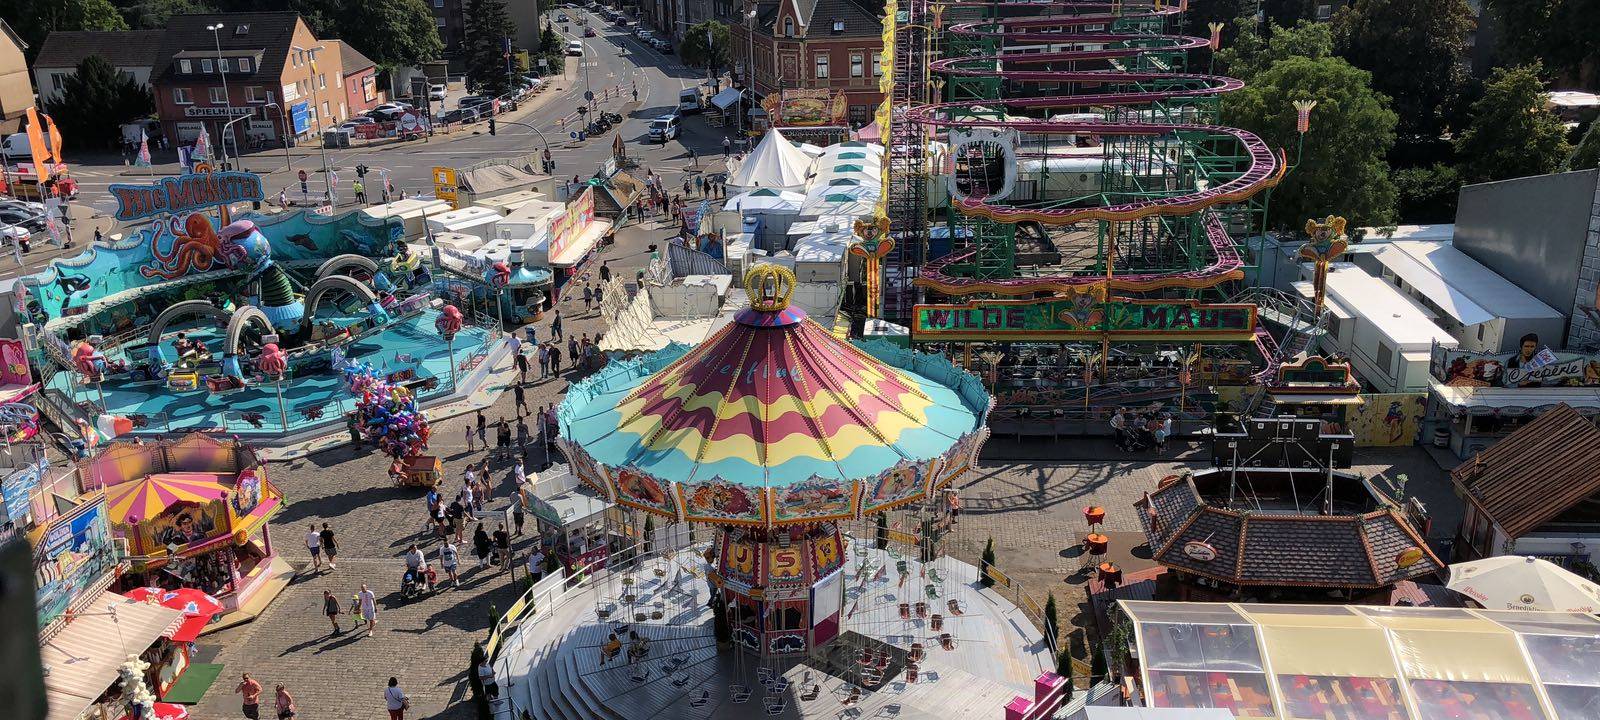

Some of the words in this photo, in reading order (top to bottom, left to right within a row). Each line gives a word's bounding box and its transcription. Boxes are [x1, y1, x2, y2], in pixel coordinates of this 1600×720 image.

[188, 107, 252, 116] SPIELHALLE
[116, 186, 166, 218] BIG
[166, 175, 260, 211] MONSTER
[926, 307, 1025, 329] WILDE
[1142, 306, 1245, 329] MAUS
